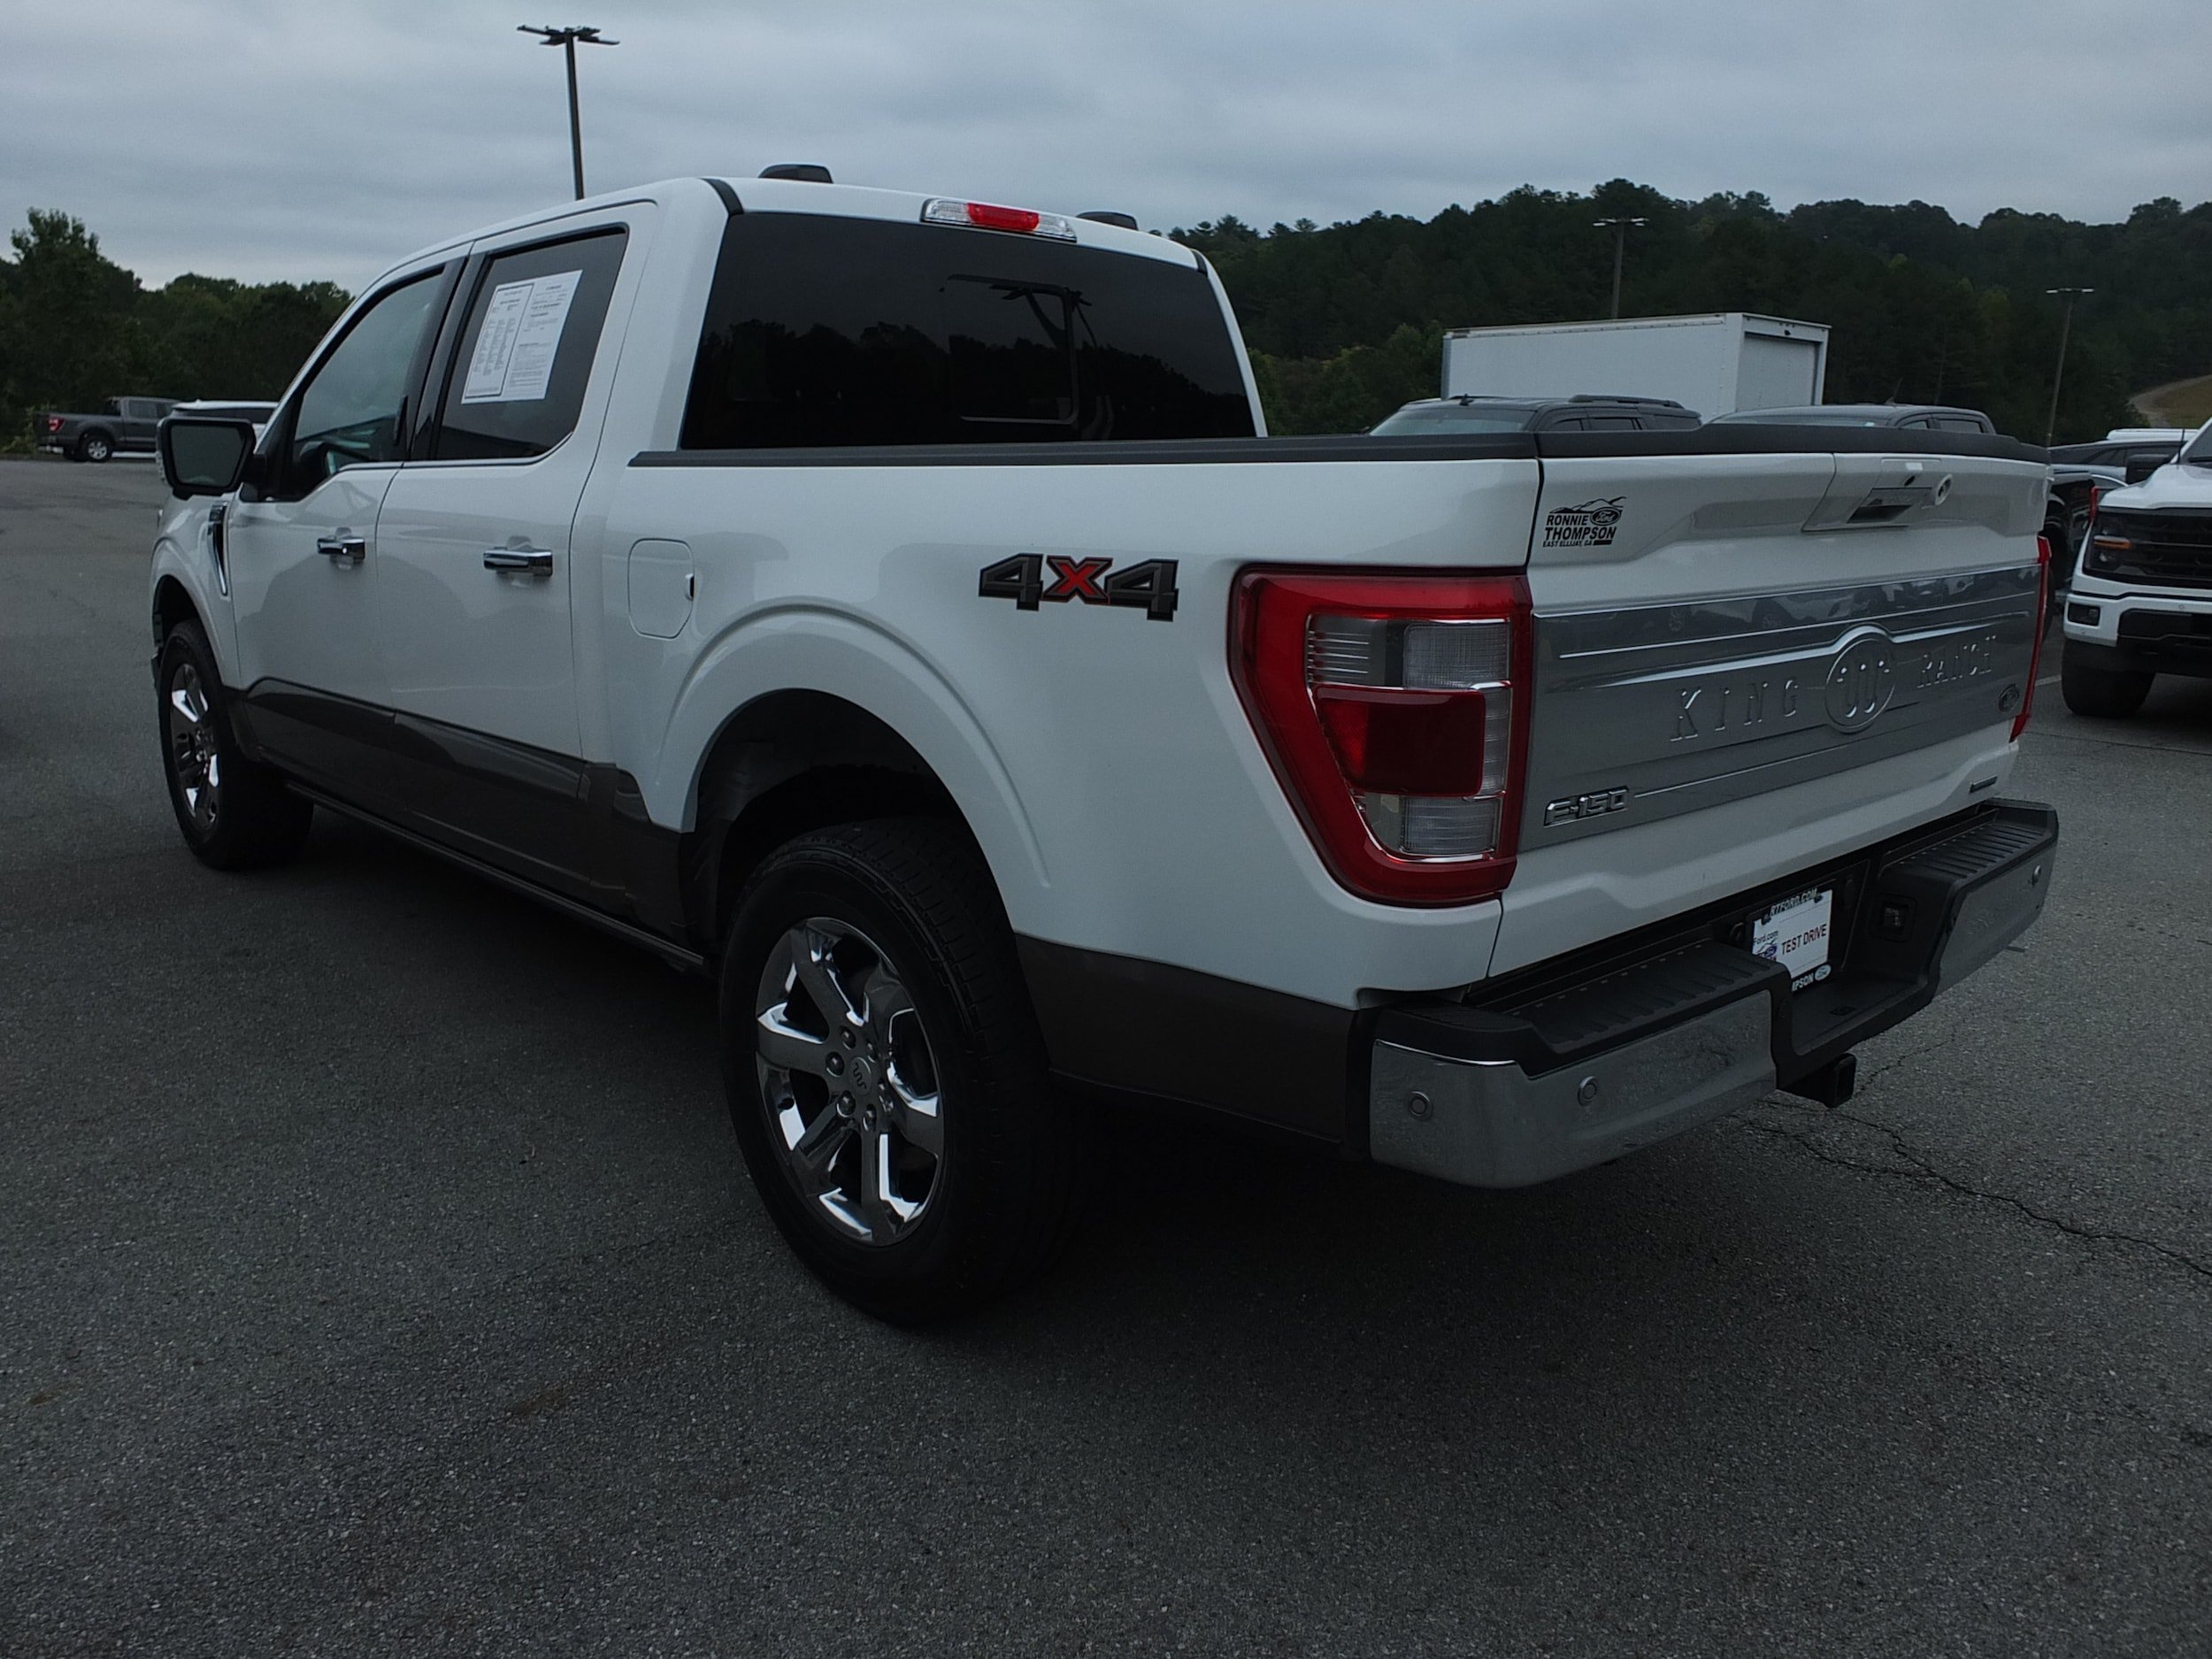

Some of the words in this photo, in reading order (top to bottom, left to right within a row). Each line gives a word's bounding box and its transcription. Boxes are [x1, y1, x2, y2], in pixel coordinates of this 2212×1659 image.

[1545, 526, 1617, 540] THOMPSON
[1547, 515, 1589, 526] RONNIE
[1670, 679, 1800, 742] KING
[1916, 634, 1997, 689] RANCH
[1544, 786, 1629, 828] F-150
[1781, 934, 1802, 956] TEST
[1802, 923, 1827, 946] DRIVE
